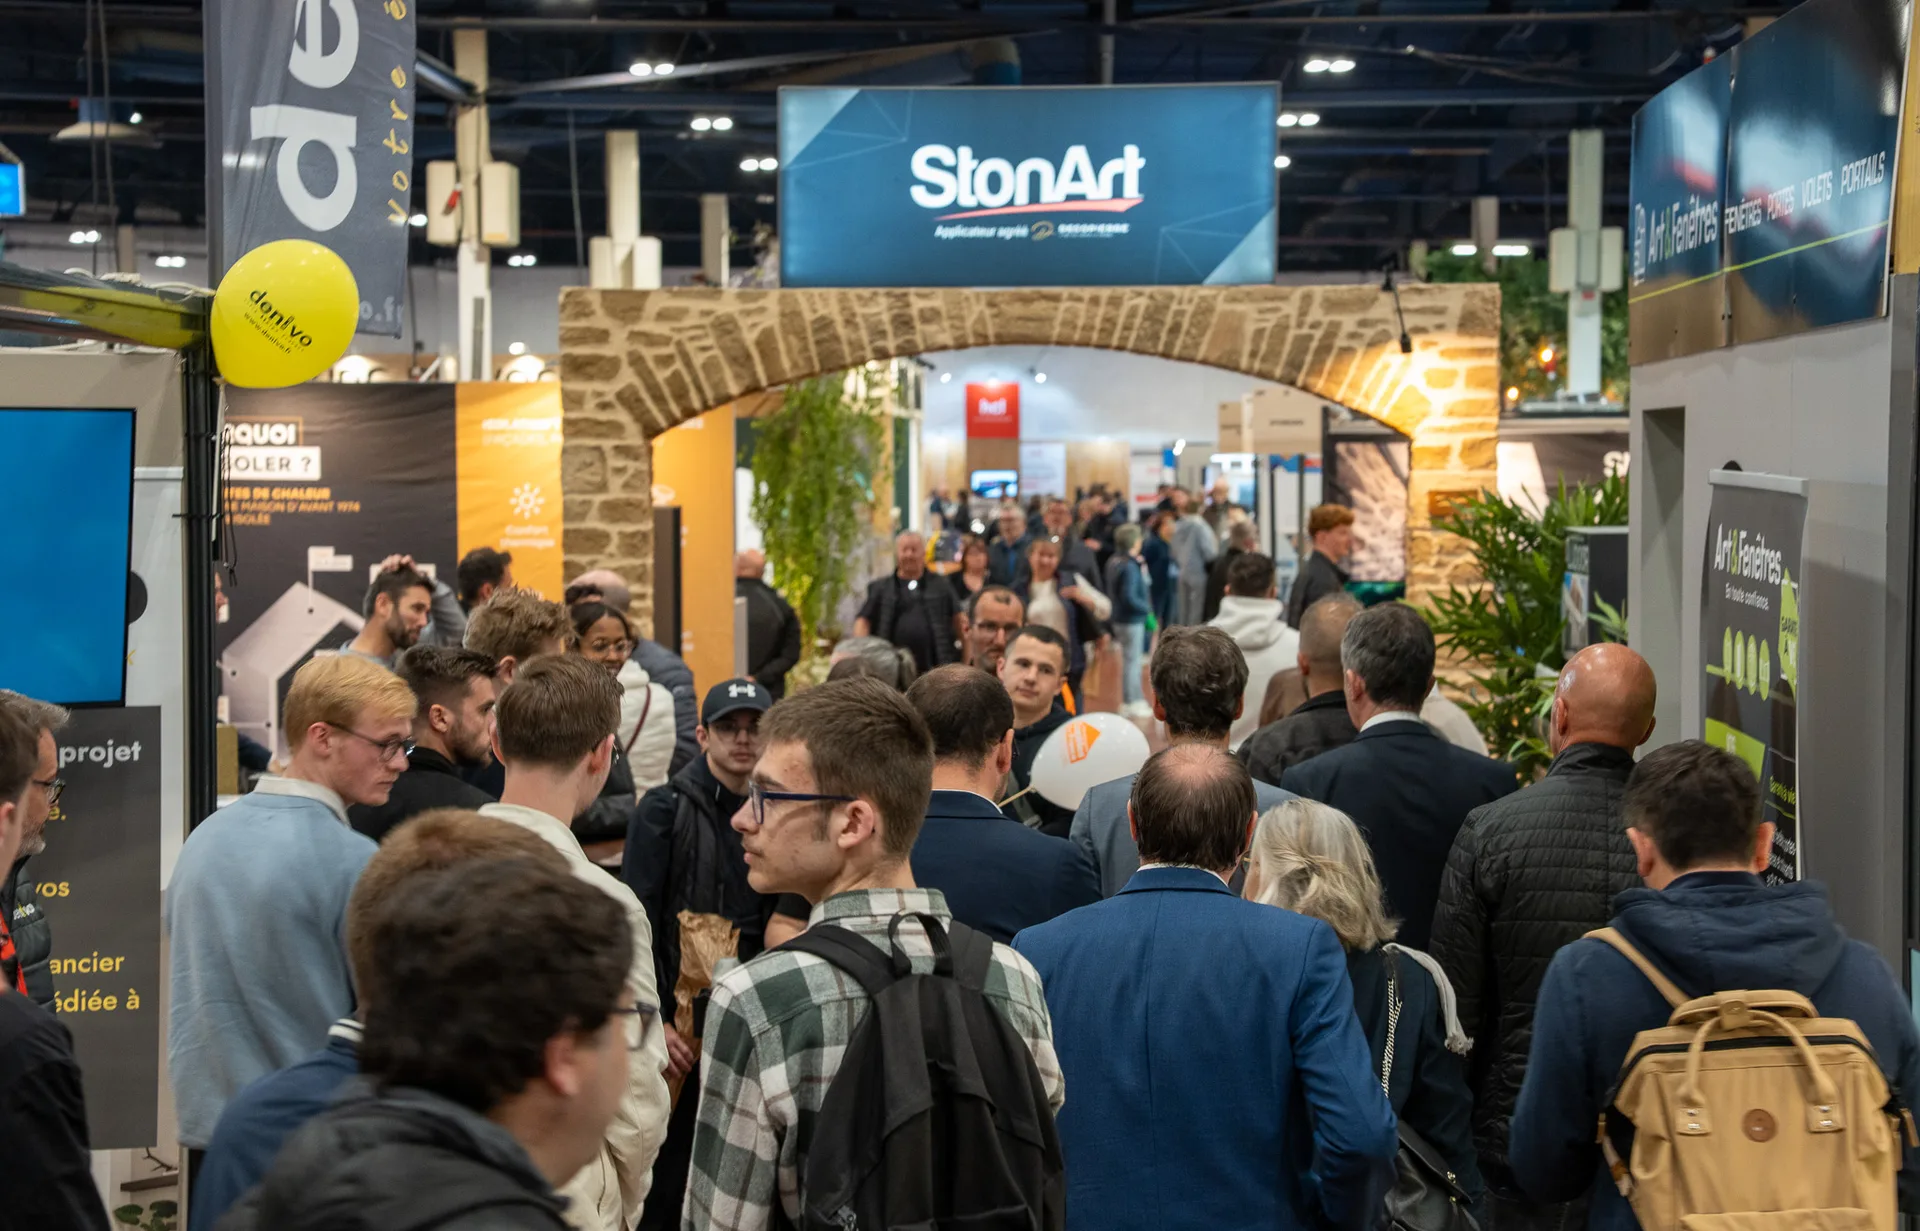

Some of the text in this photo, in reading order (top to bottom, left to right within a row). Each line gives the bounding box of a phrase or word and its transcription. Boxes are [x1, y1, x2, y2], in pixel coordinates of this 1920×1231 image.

[382, 65, 409, 227] votre
[909, 143, 1147, 209] StonArt
[1767, 184, 1795, 222] PORTES
[1801, 170, 1833, 209] VOLETS
[1840, 151, 1885, 196] PORTAILS
[59, 738, 142, 769] projet
[126, 987, 141, 1010] à
